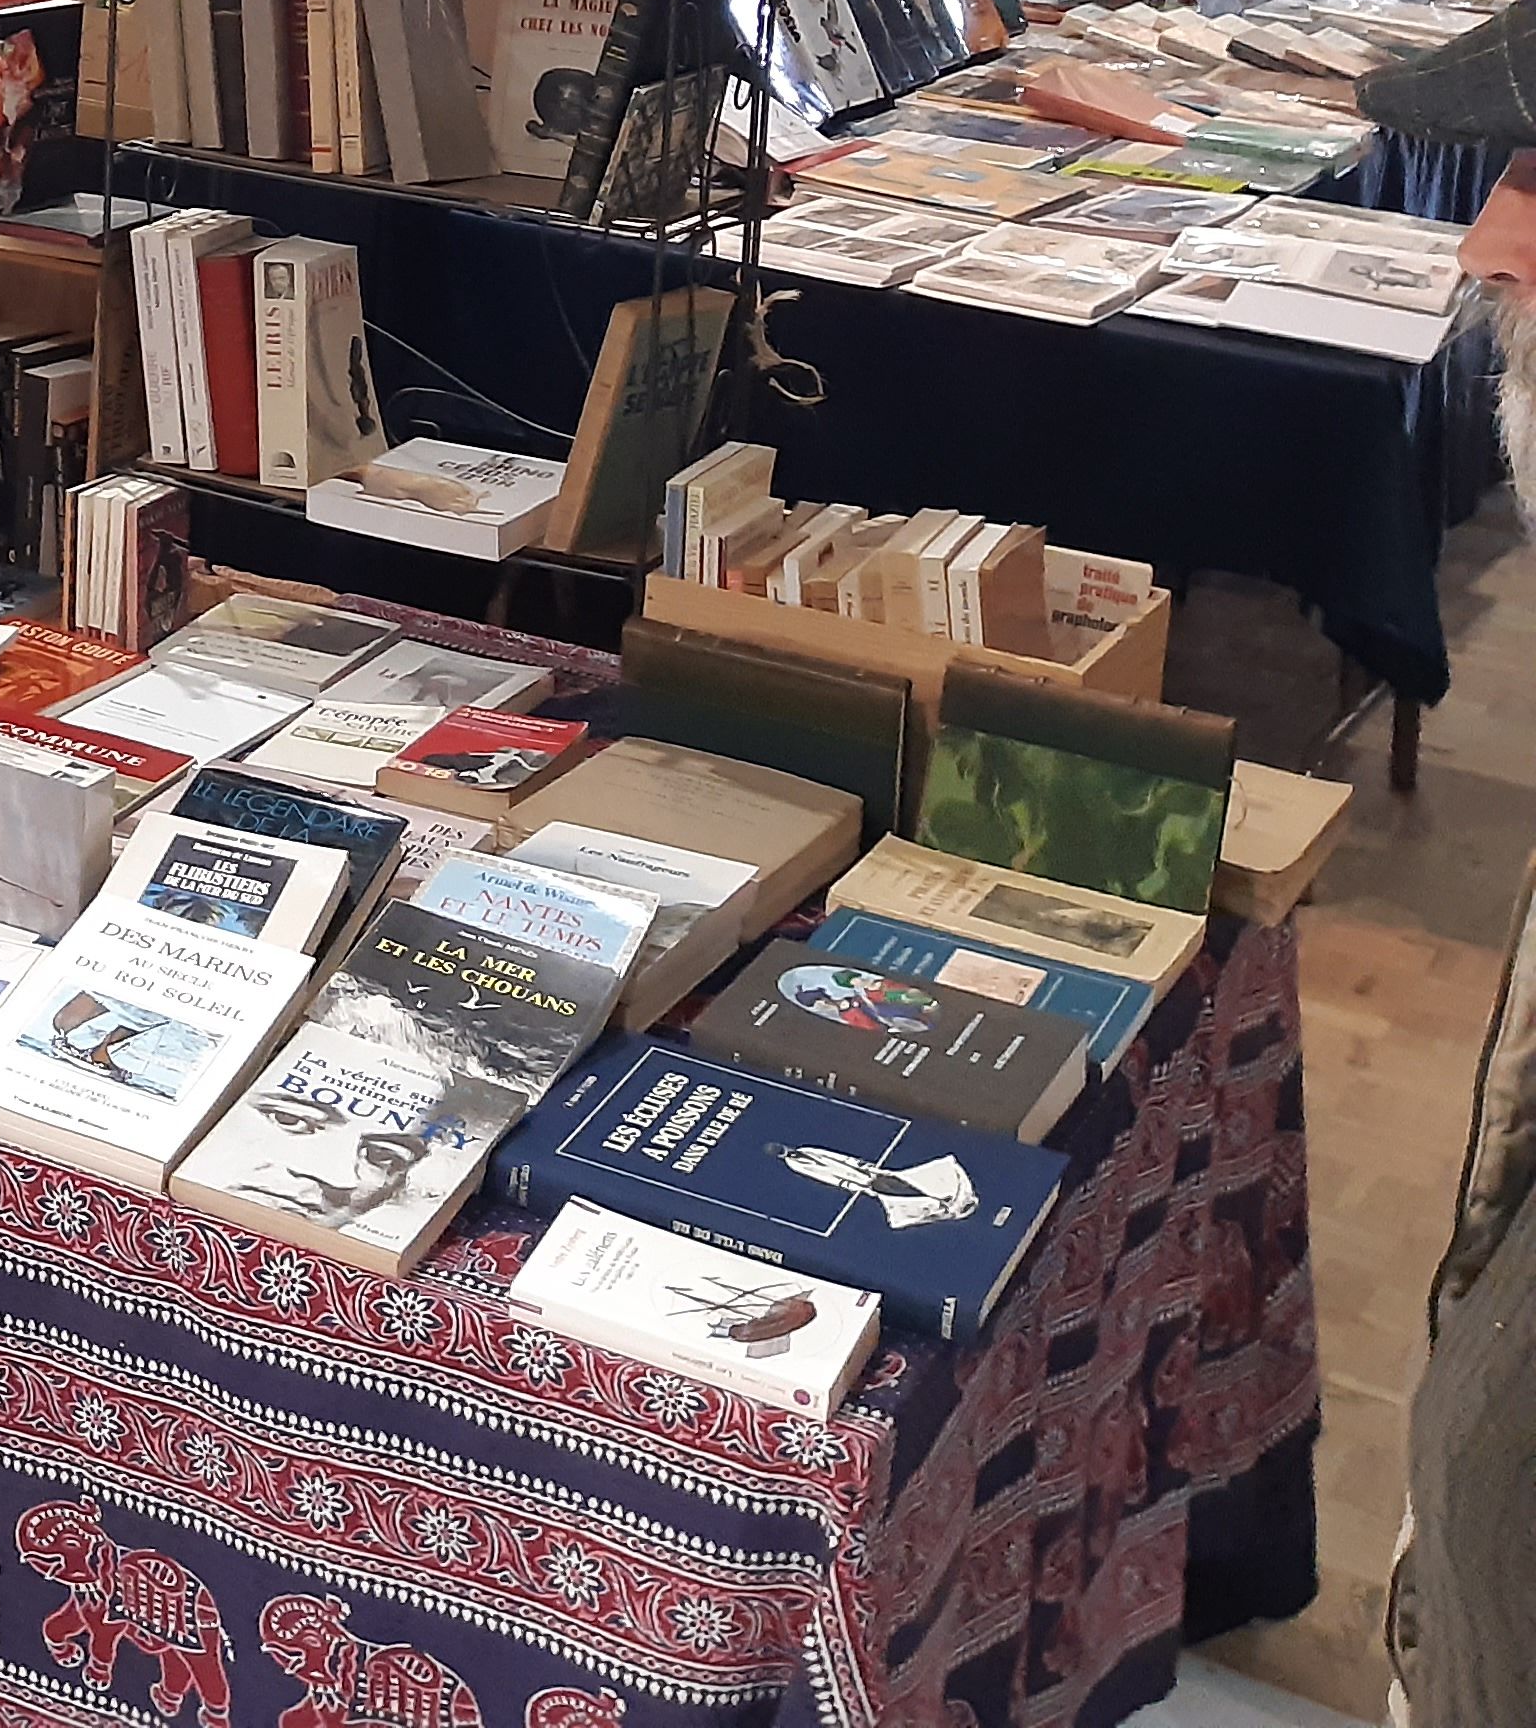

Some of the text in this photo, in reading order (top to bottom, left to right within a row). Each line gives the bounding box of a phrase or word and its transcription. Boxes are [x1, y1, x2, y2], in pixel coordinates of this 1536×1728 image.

[521, 17, 555, 32] CHEZ
[560, 20, 583, 35] LES
[265, 306, 282, 388] LEIRIS
[1079, 583, 1138, 605] pratique
[317, 706, 409, 728] L'épopée
[192, 779, 222, 798] LE
[234, 813, 276, 834] DE
[168, 862, 272, 895] FLIBUSTIERS
[578, 846, 691, 879] Les Naufrageurs
[440, 896, 603, 953] ET LE TEMPS
[480, 889, 583, 928] NANTES
[99, 921, 273, 987] DES MARINS
[128, 957, 154, 971] AU
[436, 939, 537, 984] LA MER
[75, 955, 246, 1023] DU ROI SOLEIL
[374, 937, 578, 1017] ET LES CHOUANS
[293, 1058, 313, 1076] la
[301, 1050, 328, 1069] La
[339, 1066, 402, 1094] vérité
[601, 1071, 691, 1154] LES ÉCLUSES
[641, 1083, 724, 1163] A POISSONS
[671, 1139, 707, 1175] DANS
